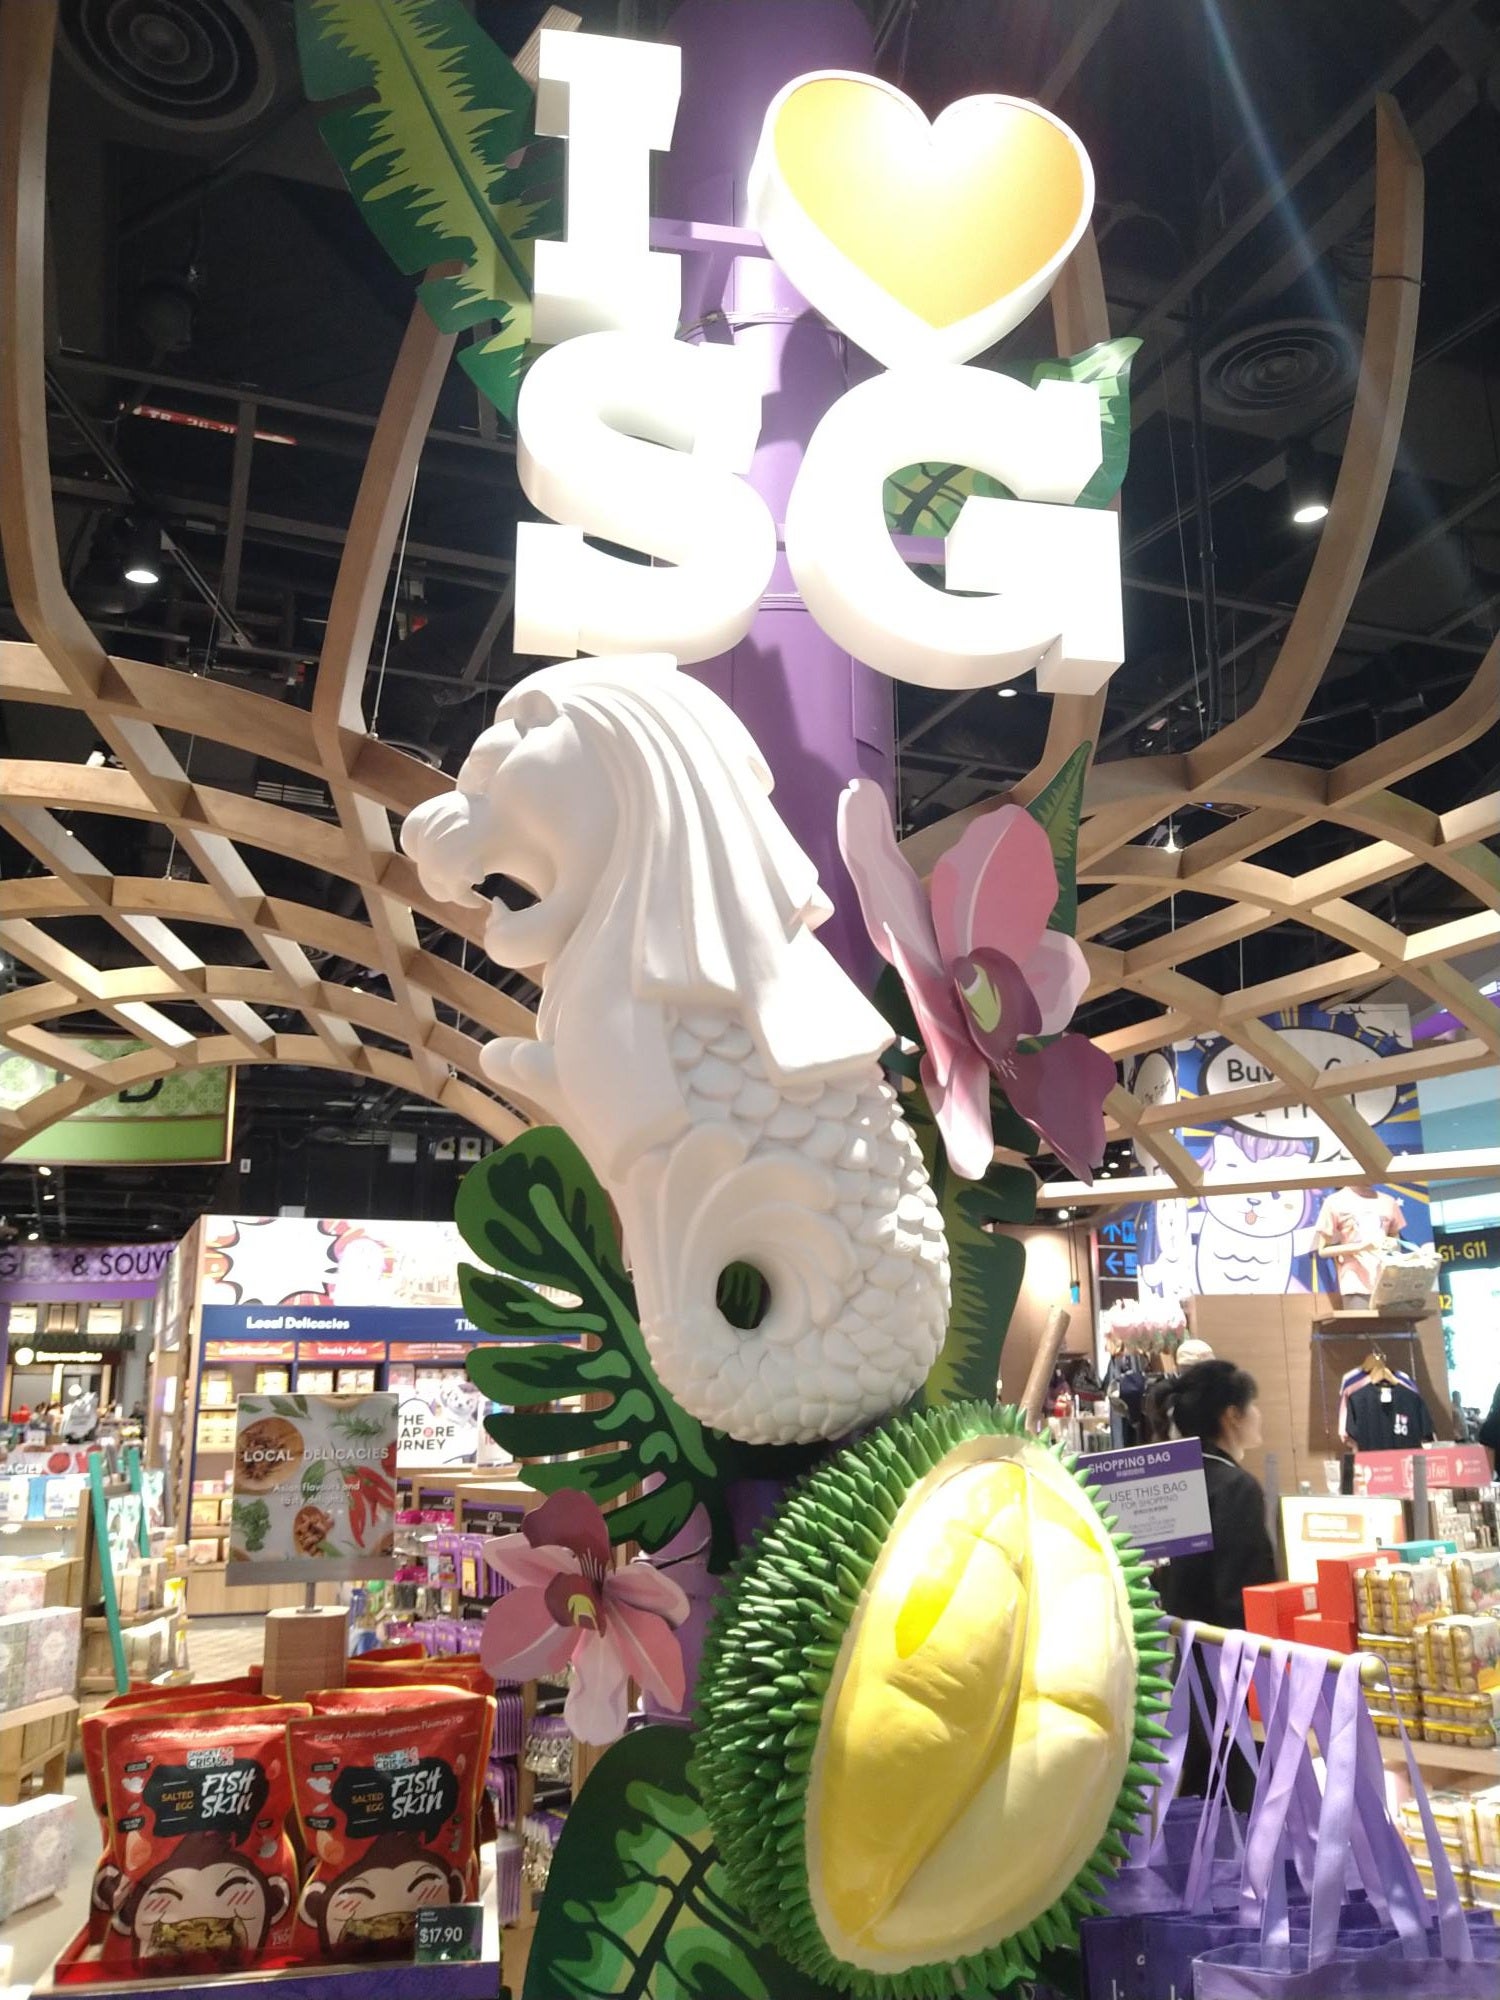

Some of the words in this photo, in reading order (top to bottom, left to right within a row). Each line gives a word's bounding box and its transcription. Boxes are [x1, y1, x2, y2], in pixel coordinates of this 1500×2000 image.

[531, 28, 684, 345] I
[513, 330, 1126, 695] SG
[71, 1253, 89, 1277] &
[246, 1316, 284, 1330] Local
[285, 1316, 350, 1330] Delicacies
[401, 1426, 455, 1438] APORE
[243, 1449, 295, 1463] LOCAL
[303, 1448, 390, 1461] DELICACIES
[1087, 1454, 1146, 1475] SHOPPING
[1147, 1451, 1171, 1465] BAG
[1109, 1489, 1131, 1503] USE
[1135, 1485, 1161, 1498] THIS
[1163, 1480, 1188, 1494] BAG
[201, 1768, 256, 1797] FISH
[390, 1767, 442, 1797] FISH
[161, 1790, 194, 1802] SALTED
[175, 1800, 195, 1811] EGG
[200, 1791, 253, 1819] SKIN
[352, 1792, 385, 1804] SALTED
[391, 1790, 444, 1819] SKIN
[366, 1802, 385, 1814] EGG
[419, 1926, 463, 1944] $17.90
